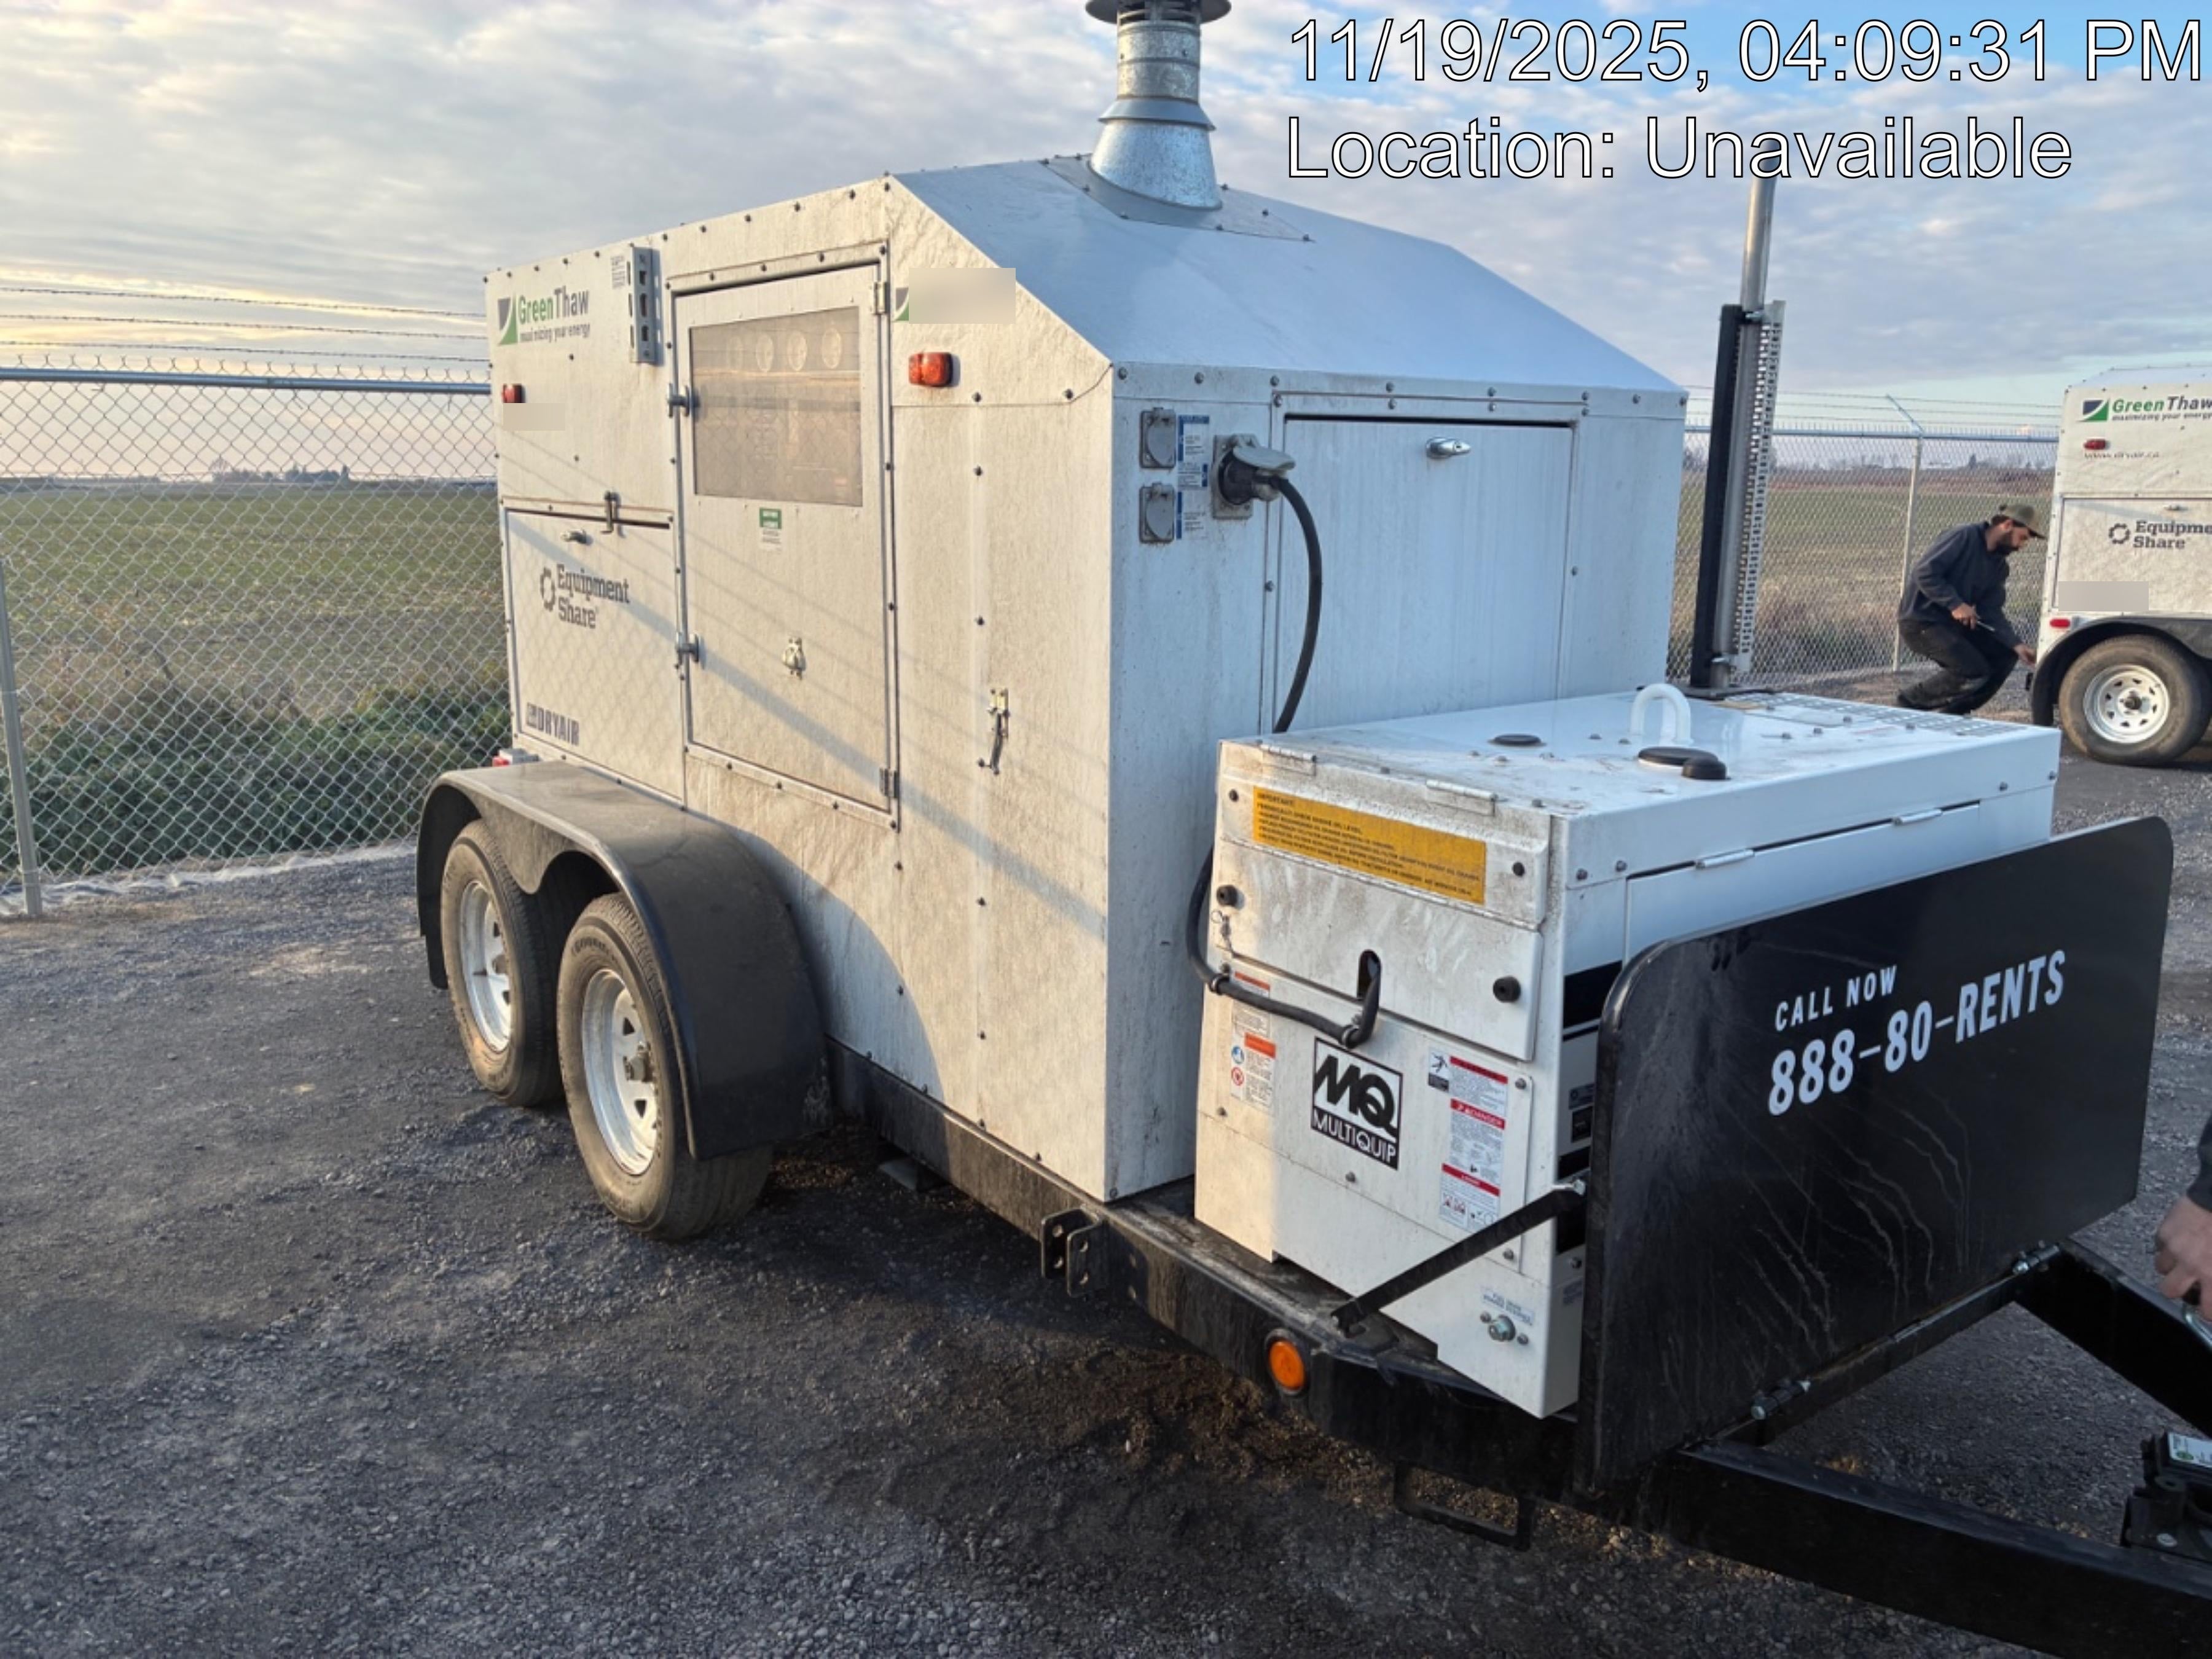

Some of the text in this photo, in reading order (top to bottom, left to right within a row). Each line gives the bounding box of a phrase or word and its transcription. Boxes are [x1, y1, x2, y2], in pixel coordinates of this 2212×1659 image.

[2133, 536, 2186, 549] Share
[557, 563, 630, 604] Equipment
[558, 596, 596, 629] Share
[1775, 965, 1897, 1032] CALL NOW
[1768, 949, 2066, 1116] 888-80-RENTS
[1314, 1054, 1398, 1139] MQ
[1312, 1108, 1397, 1164] MULTIQUIP
